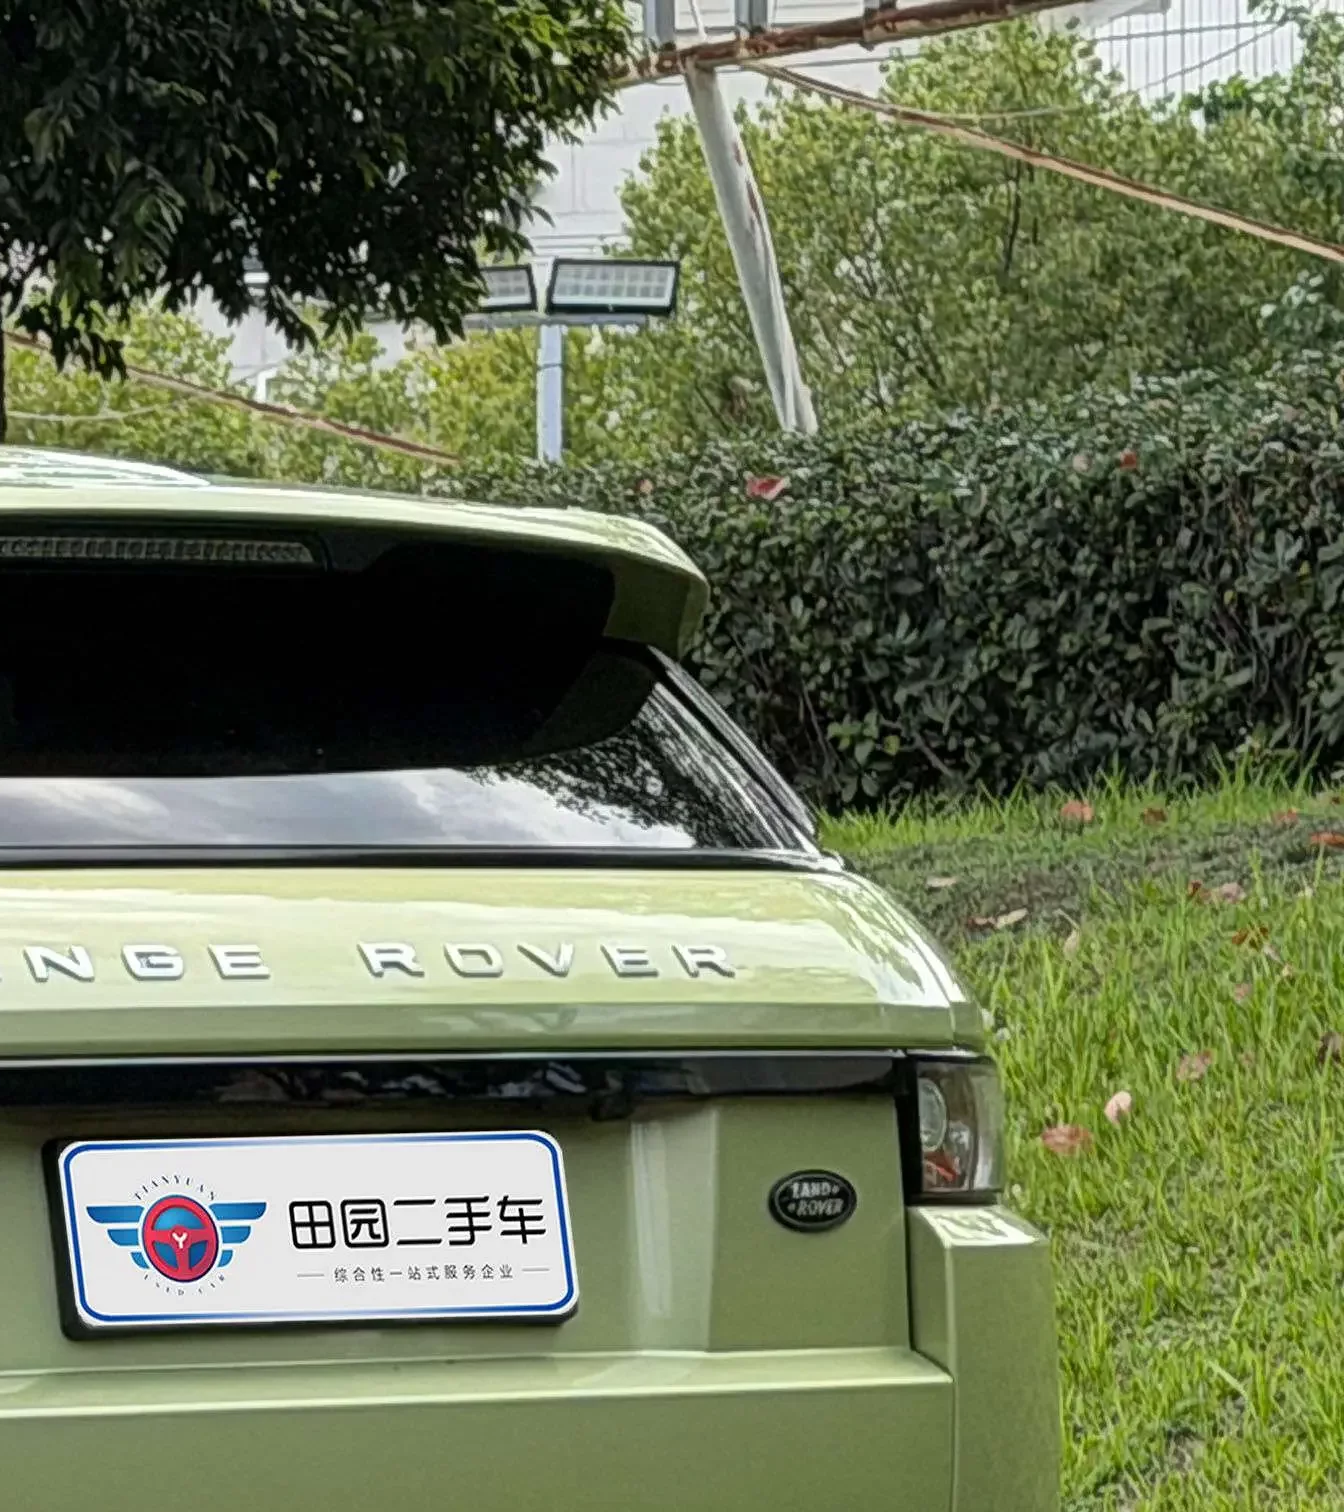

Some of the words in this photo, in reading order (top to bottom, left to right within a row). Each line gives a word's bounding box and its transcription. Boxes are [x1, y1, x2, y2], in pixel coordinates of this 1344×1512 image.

[356, 941, 736, 979] ROVER
[791, 1181, 832, 1199] LAND
[796, 1198, 845, 1218] ROVER
[288, 1195, 547, 1250] 田园二手车
[333, 1263, 514, 1283] 综合性一站式服务企业
